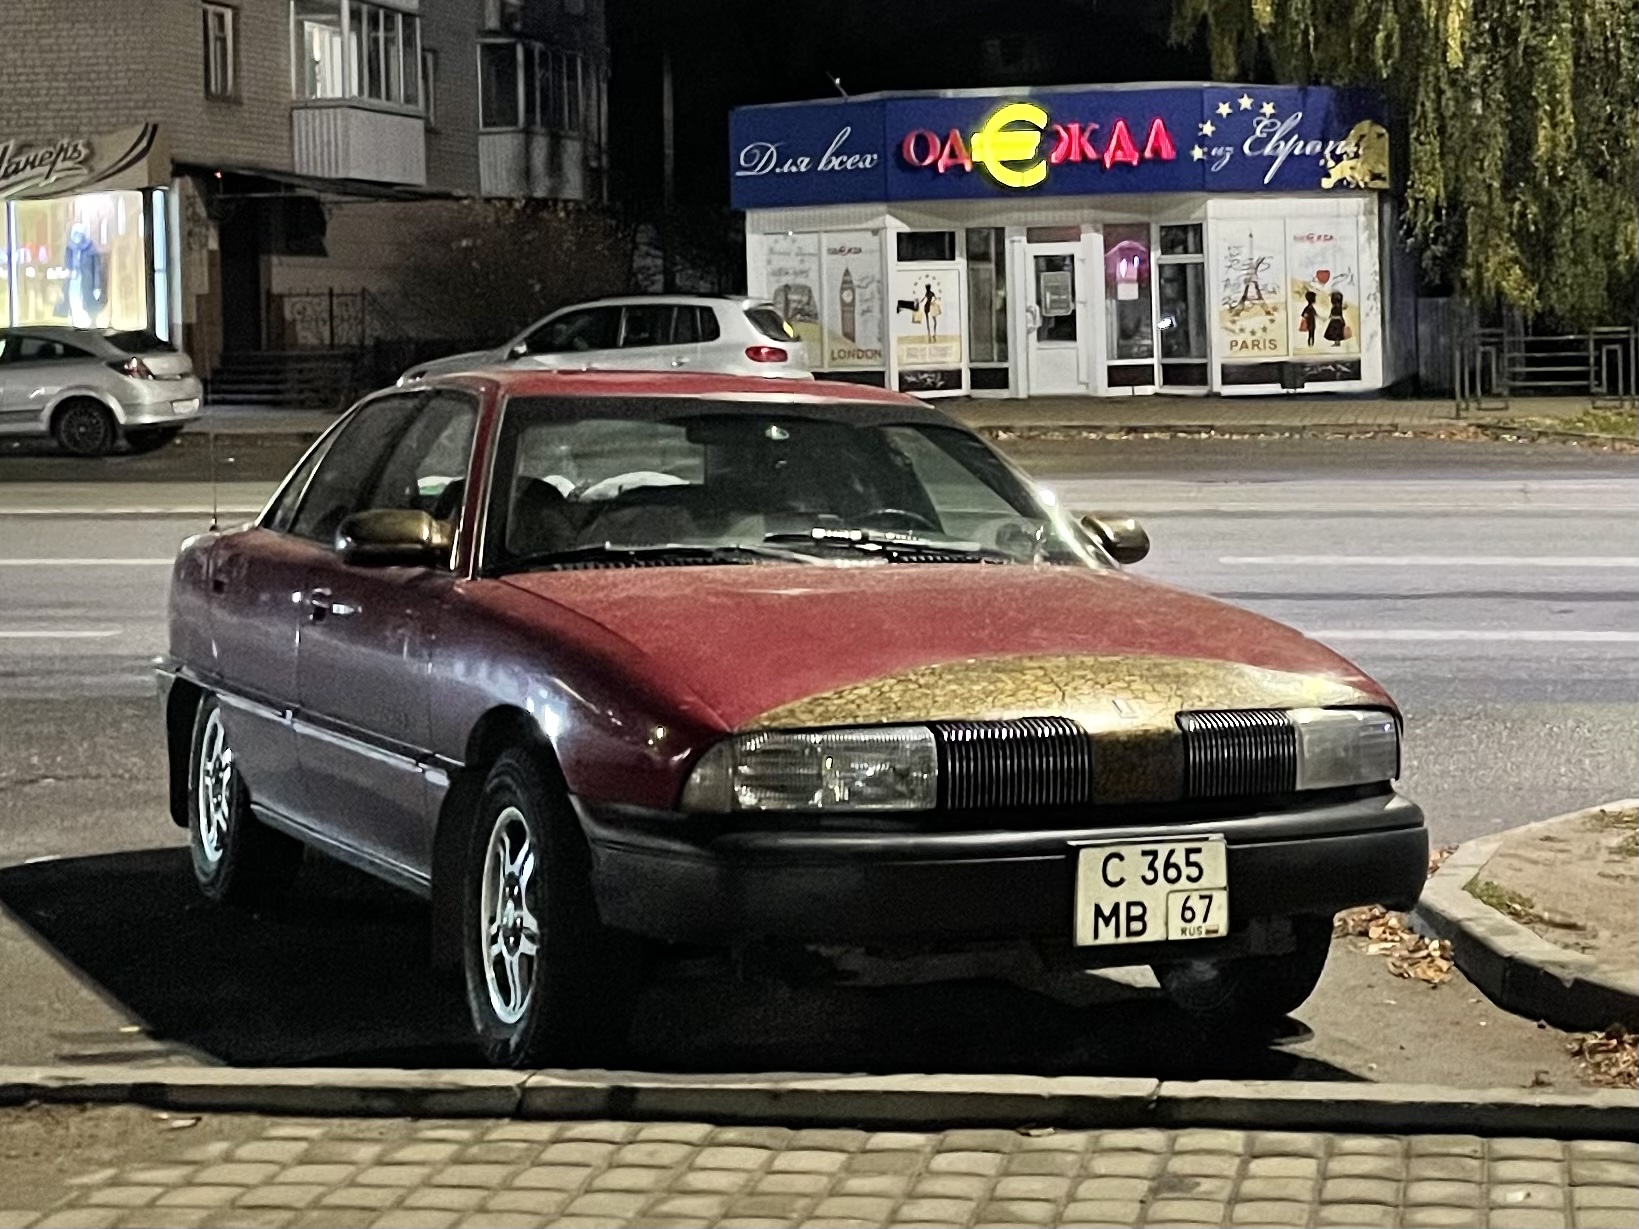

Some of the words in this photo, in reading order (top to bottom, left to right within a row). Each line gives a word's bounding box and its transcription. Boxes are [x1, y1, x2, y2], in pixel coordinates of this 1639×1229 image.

[735, 142, 811, 176] Для
[817, 126, 878, 172] всех
[1211, 146, 1234, 172] из
[831, 348, 881, 361] LONDON
[1230, 338, 1277, 351] PARIS
[1141, 847, 1203, 886] 365
[1181, 894, 1213, 923] 67
[1180, 925, 1203, 937] RUS
